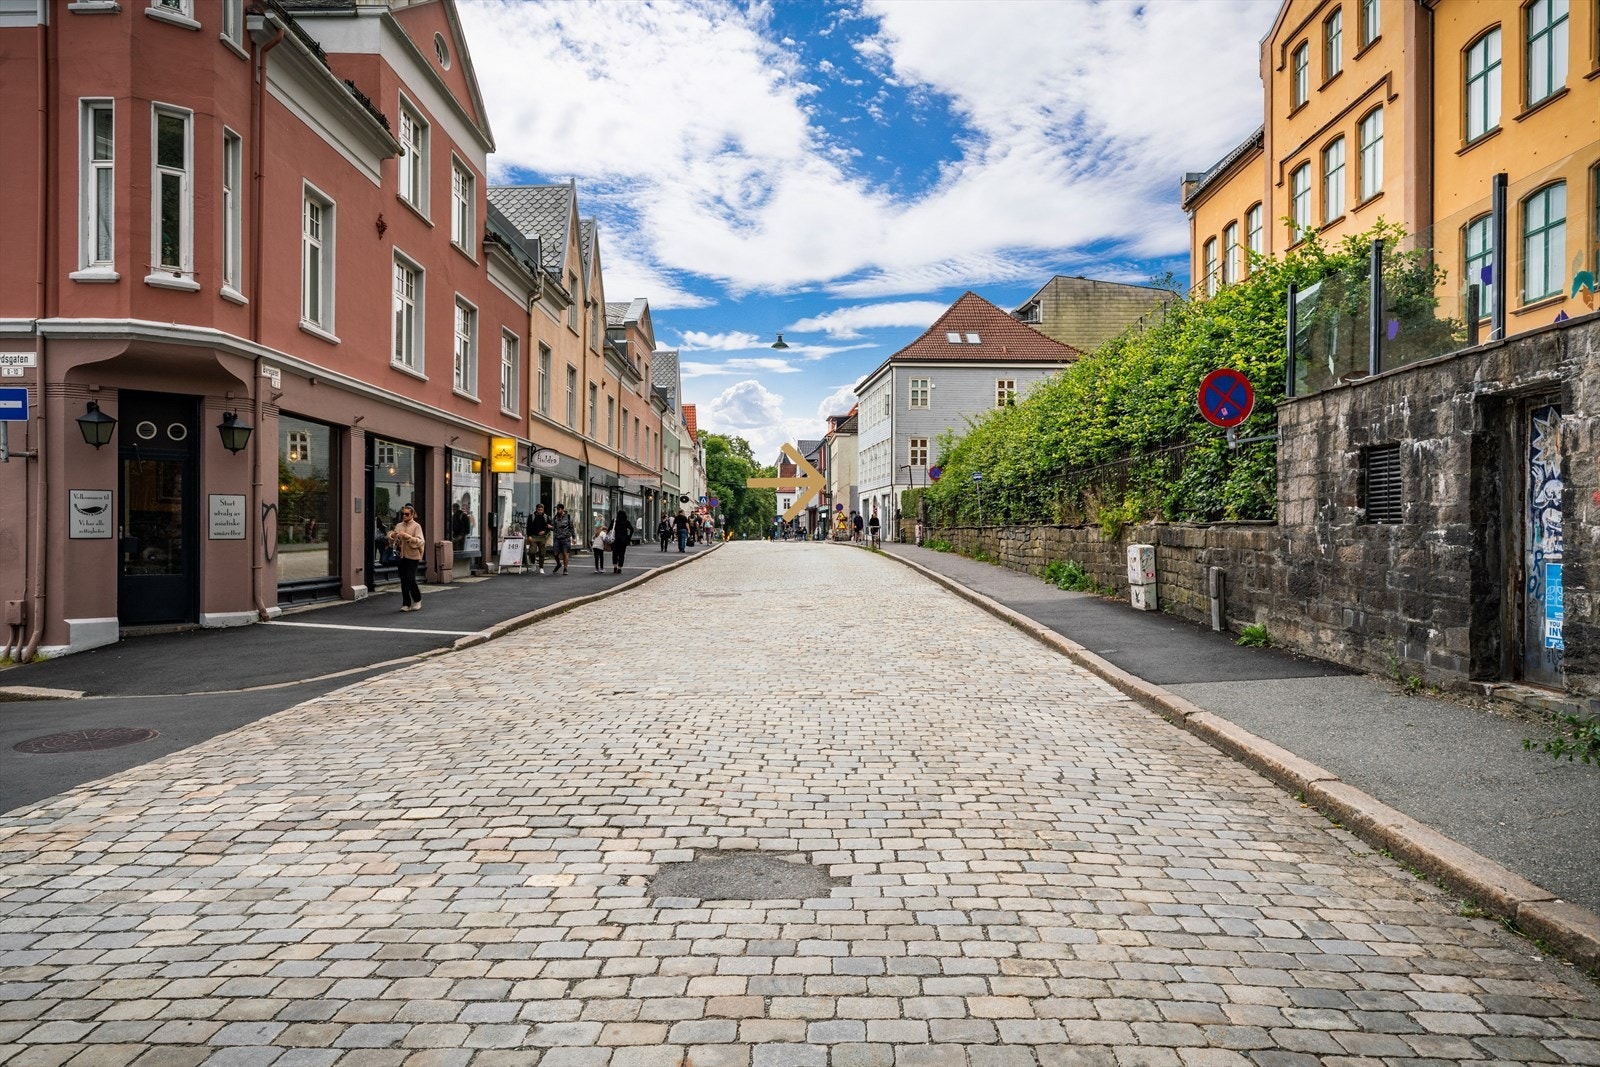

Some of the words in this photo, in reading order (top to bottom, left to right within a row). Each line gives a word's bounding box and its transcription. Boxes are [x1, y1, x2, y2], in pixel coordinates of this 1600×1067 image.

[0, 355, 29, 366] dsgaten
[219, 498, 236, 506] Stort
[213, 508, 233, 517] utvalg
[214, 518, 240, 526] asiatiske
